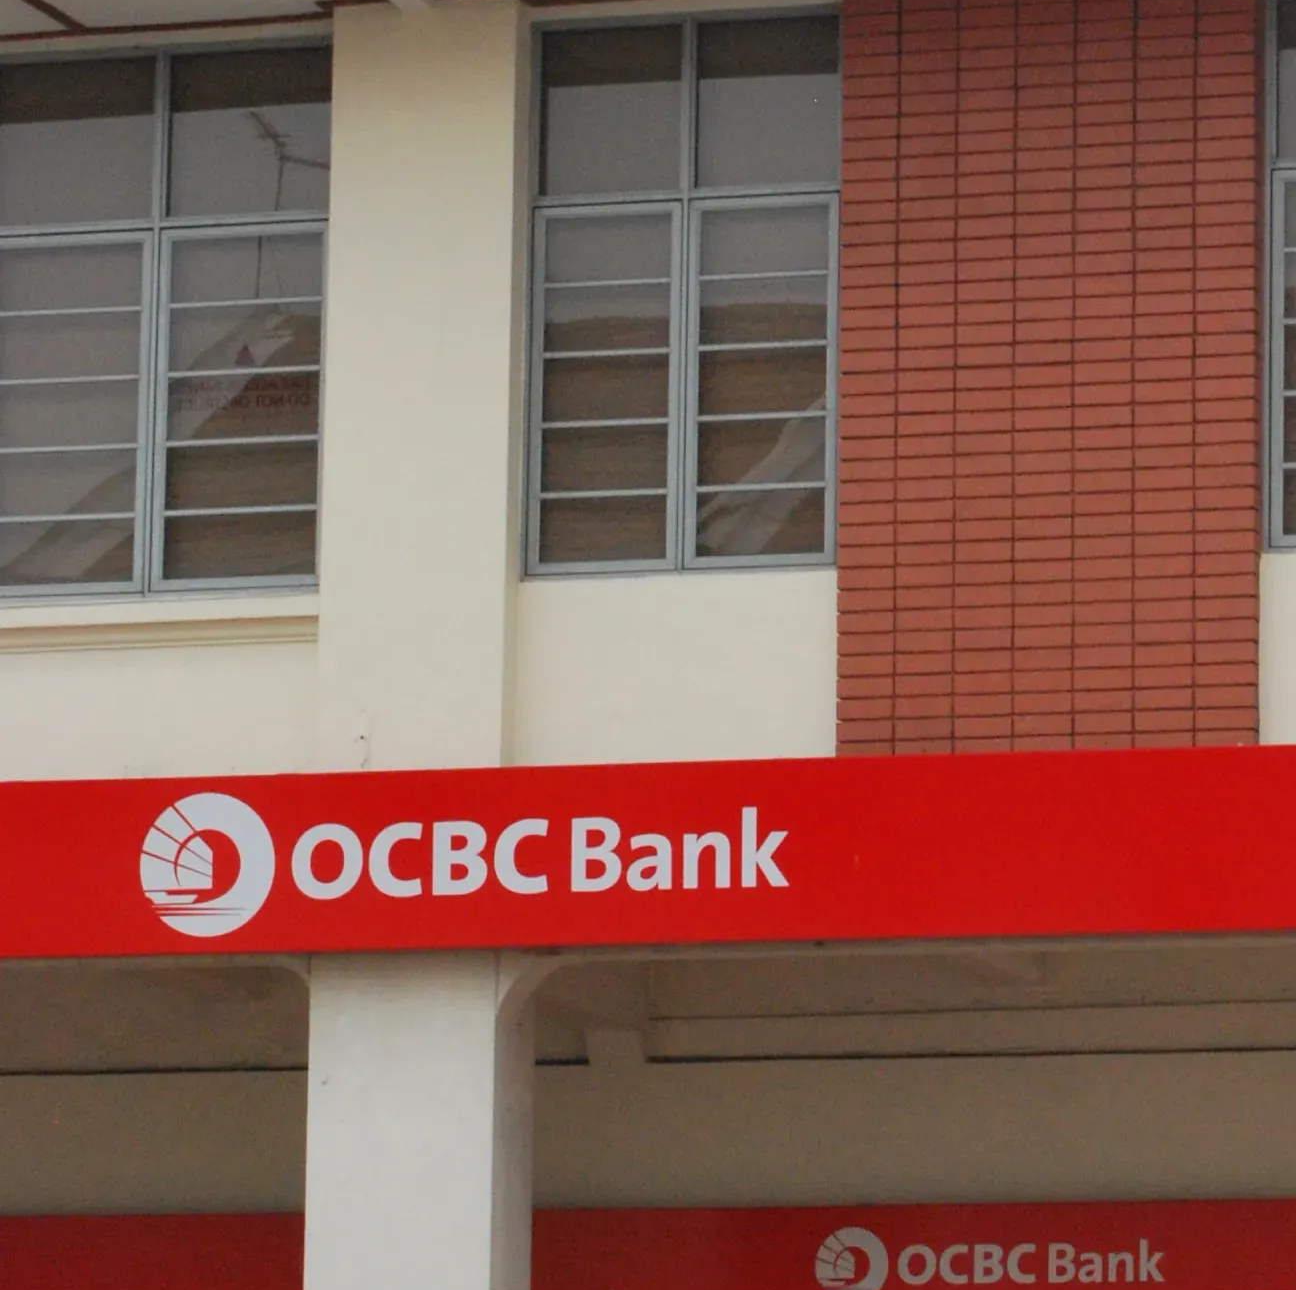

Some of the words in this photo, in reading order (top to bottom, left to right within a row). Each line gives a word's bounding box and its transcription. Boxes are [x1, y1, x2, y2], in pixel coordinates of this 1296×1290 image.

[291, 817, 549, 901] OCBC
[570, 806, 789, 893] Bank
[897, 1243, 1036, 1285] OCBC
[1047, 1239, 1165, 1283] Bank
